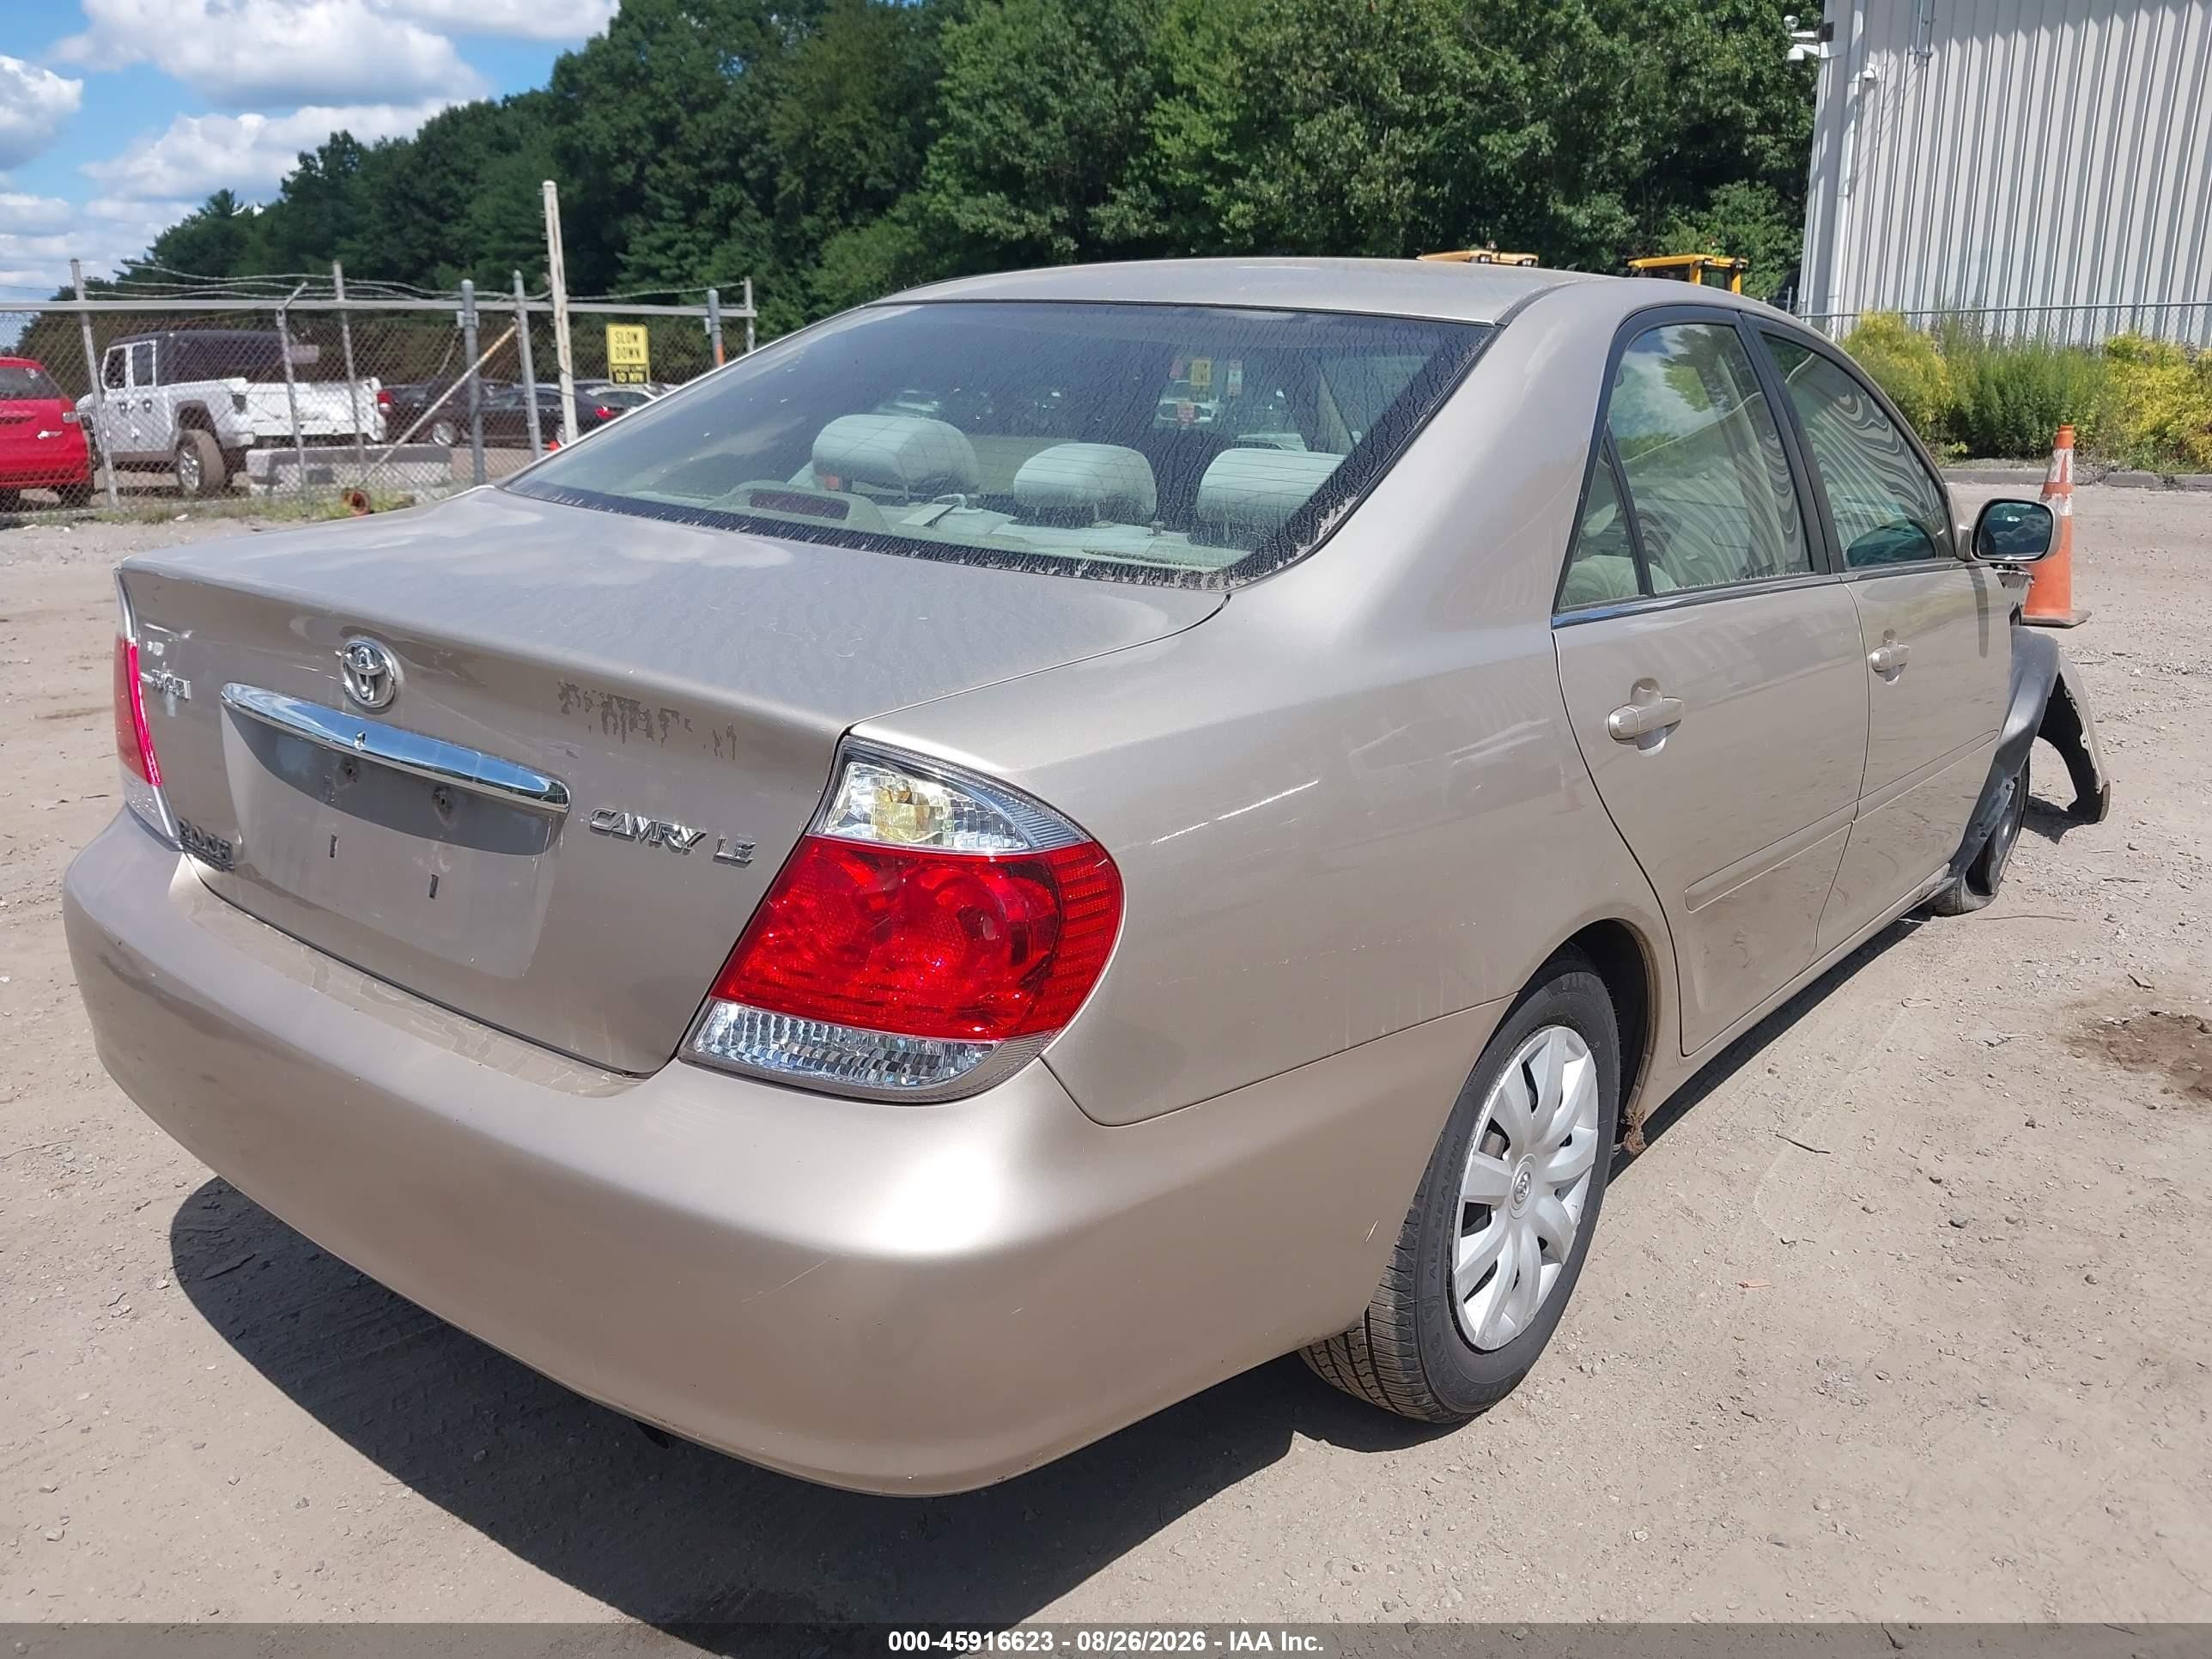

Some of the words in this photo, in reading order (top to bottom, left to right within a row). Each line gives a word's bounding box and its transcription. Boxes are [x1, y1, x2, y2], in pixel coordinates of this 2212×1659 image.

[614, 331, 639, 344] SLOW
[616, 346, 641, 360] DOWN
[590, 808, 708, 851] CAMRY
[714, 836, 757, 866] LE
